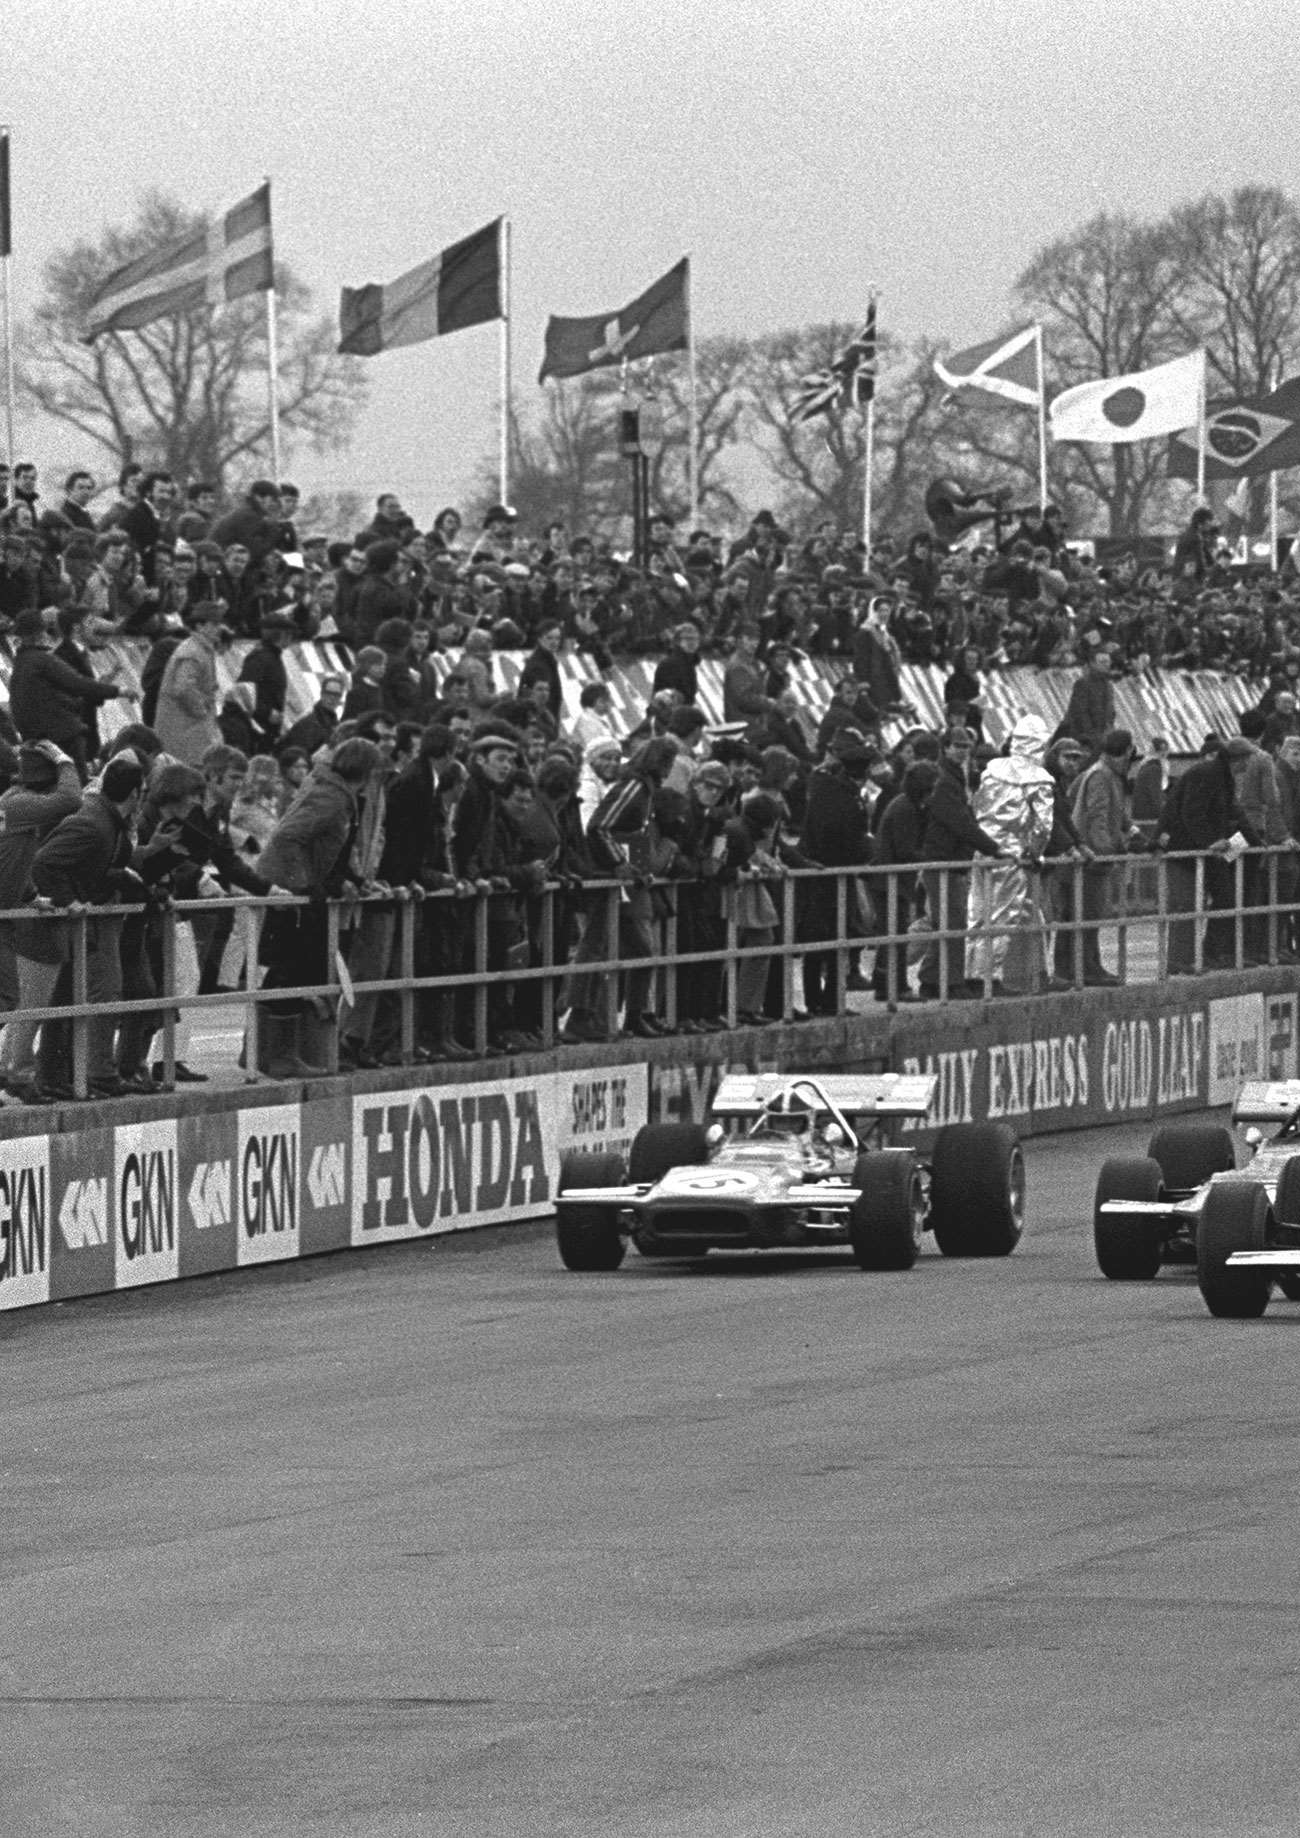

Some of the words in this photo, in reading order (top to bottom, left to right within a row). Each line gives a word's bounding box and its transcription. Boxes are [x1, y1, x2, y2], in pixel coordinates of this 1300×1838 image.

[987, 1033, 1089, 1120] EXPRESS
[1103, 1019, 1152, 1112] GOLD
[1157, 1011, 1204, 1106] LEAF
[121, 1148, 174, 1261] GKN
[244, 1132, 297, 1239] GKN
[361, 1090, 550, 1229] HONDA
